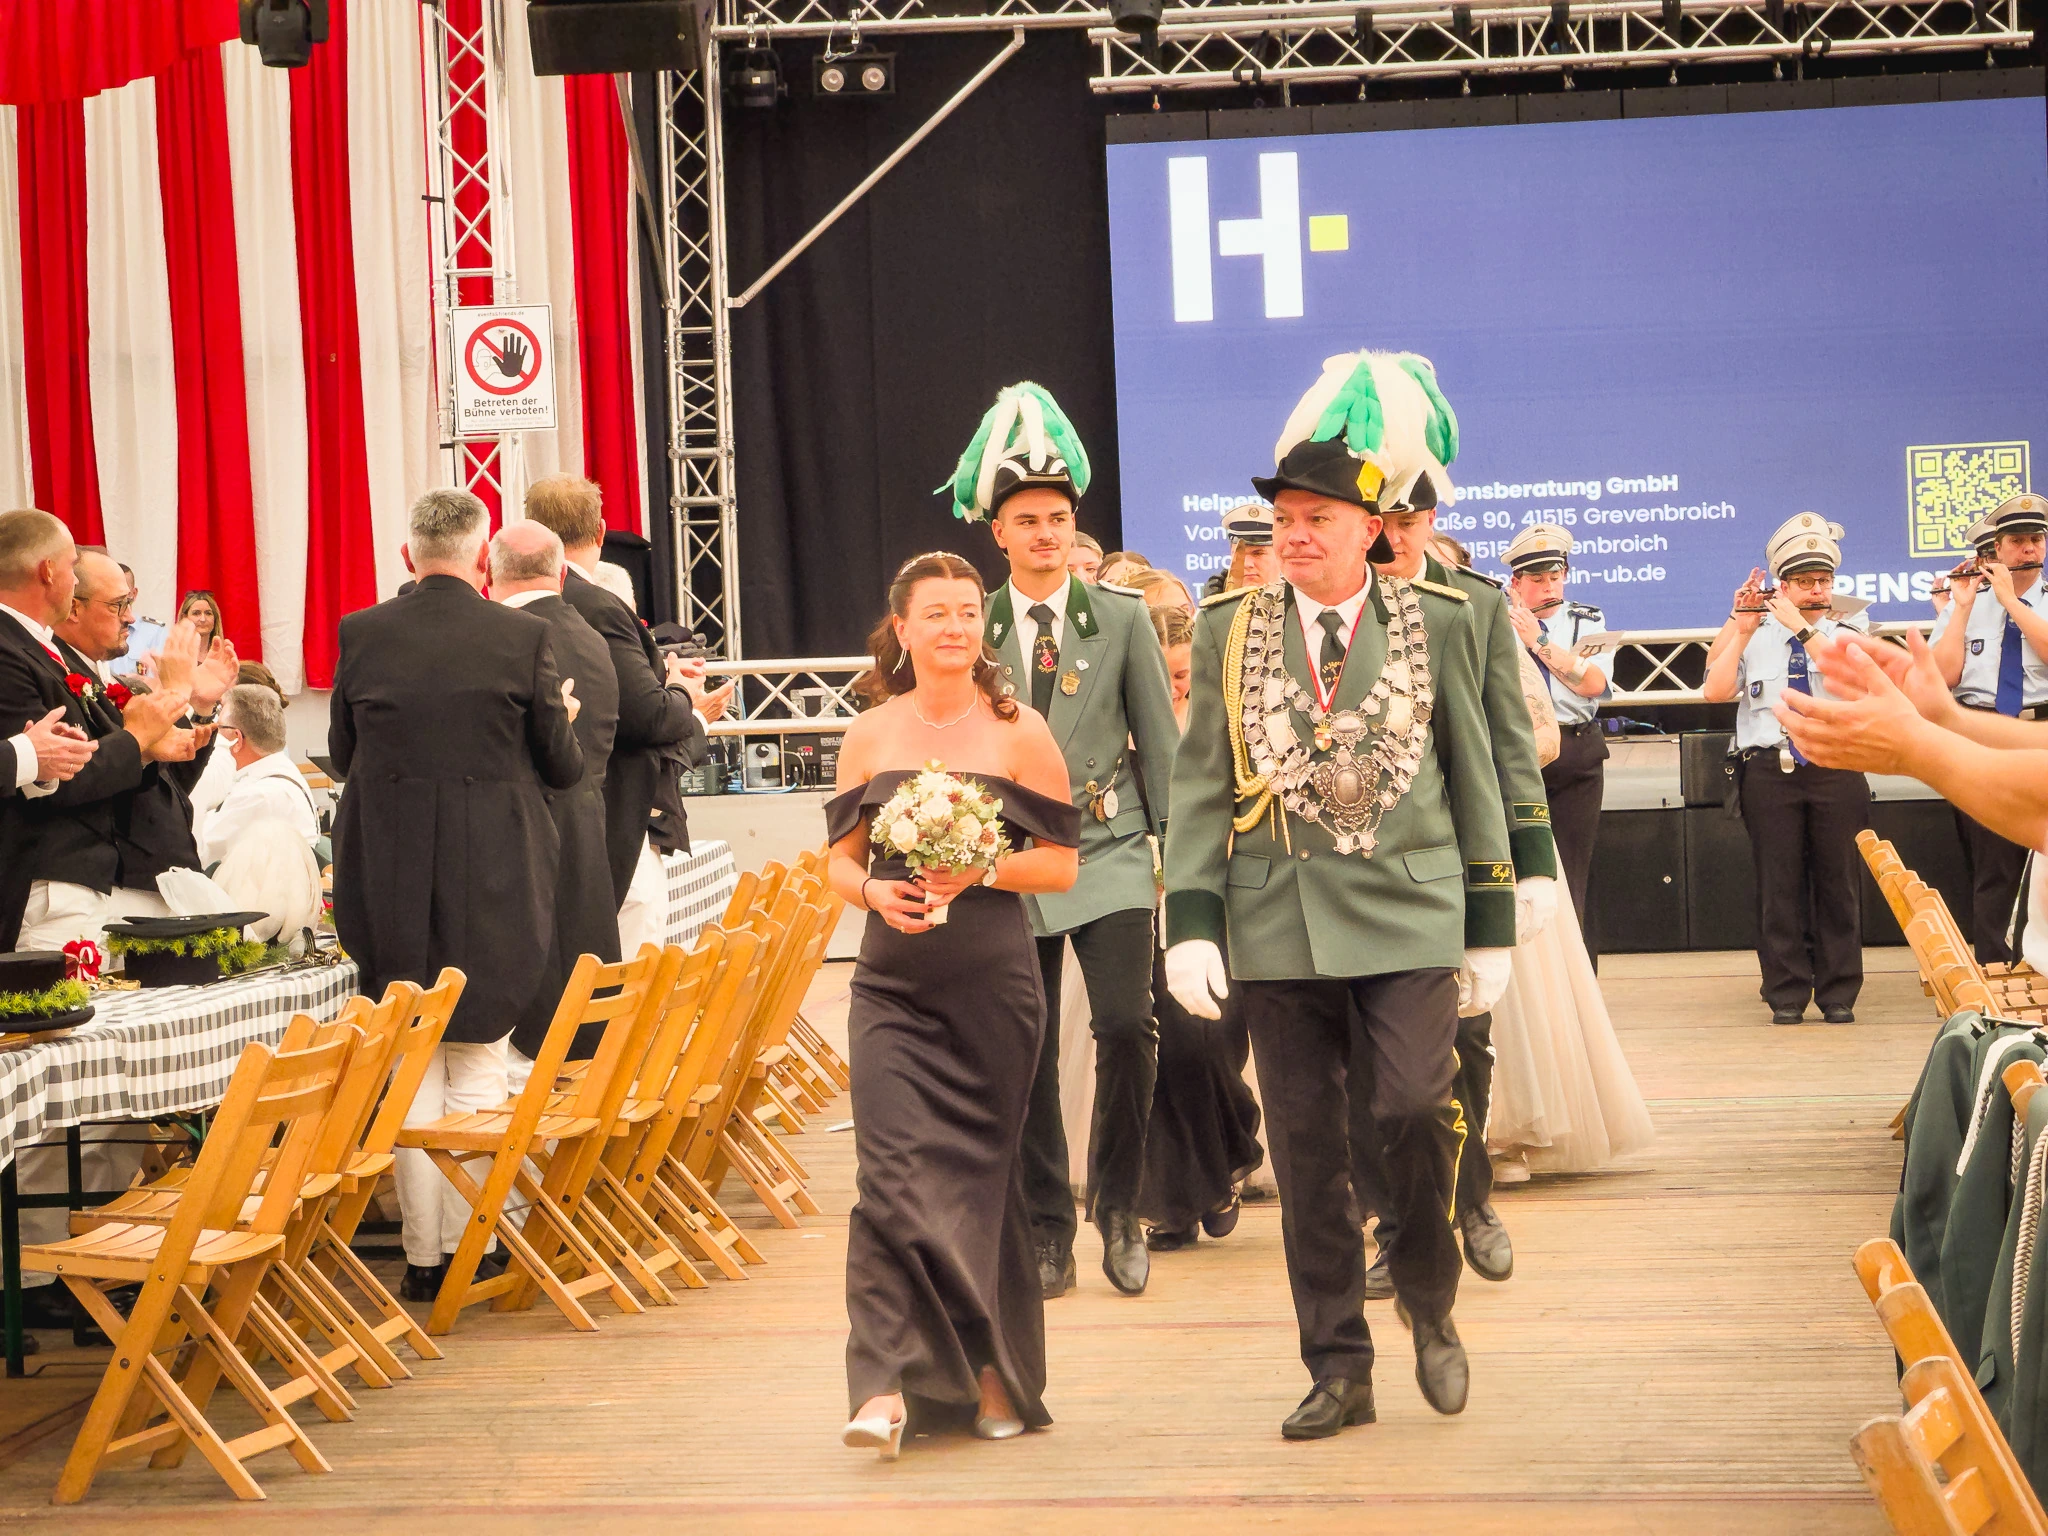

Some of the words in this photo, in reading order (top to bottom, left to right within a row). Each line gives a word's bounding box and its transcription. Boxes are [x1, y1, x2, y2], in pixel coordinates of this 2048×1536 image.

[1168, 152, 1303, 323] H
[465, 408, 496, 417] Bühne
[500, 405, 549, 416] verboten!
[474, 398, 518, 408] Betreten
[522, 397, 538, 405] der
[1453, 480, 1602, 501] ensberatung
[1605, 474, 1679, 494] GmbH
[1434, 511, 1477, 531] aße
[1482, 510, 1516, 531] 90,
[1521, 508, 1578, 527] 41515
[1583, 500, 1736, 525] Grevenbroich
[1570, 533, 1668, 555] enbroich
[1833, 570, 1949, 603] PENS
